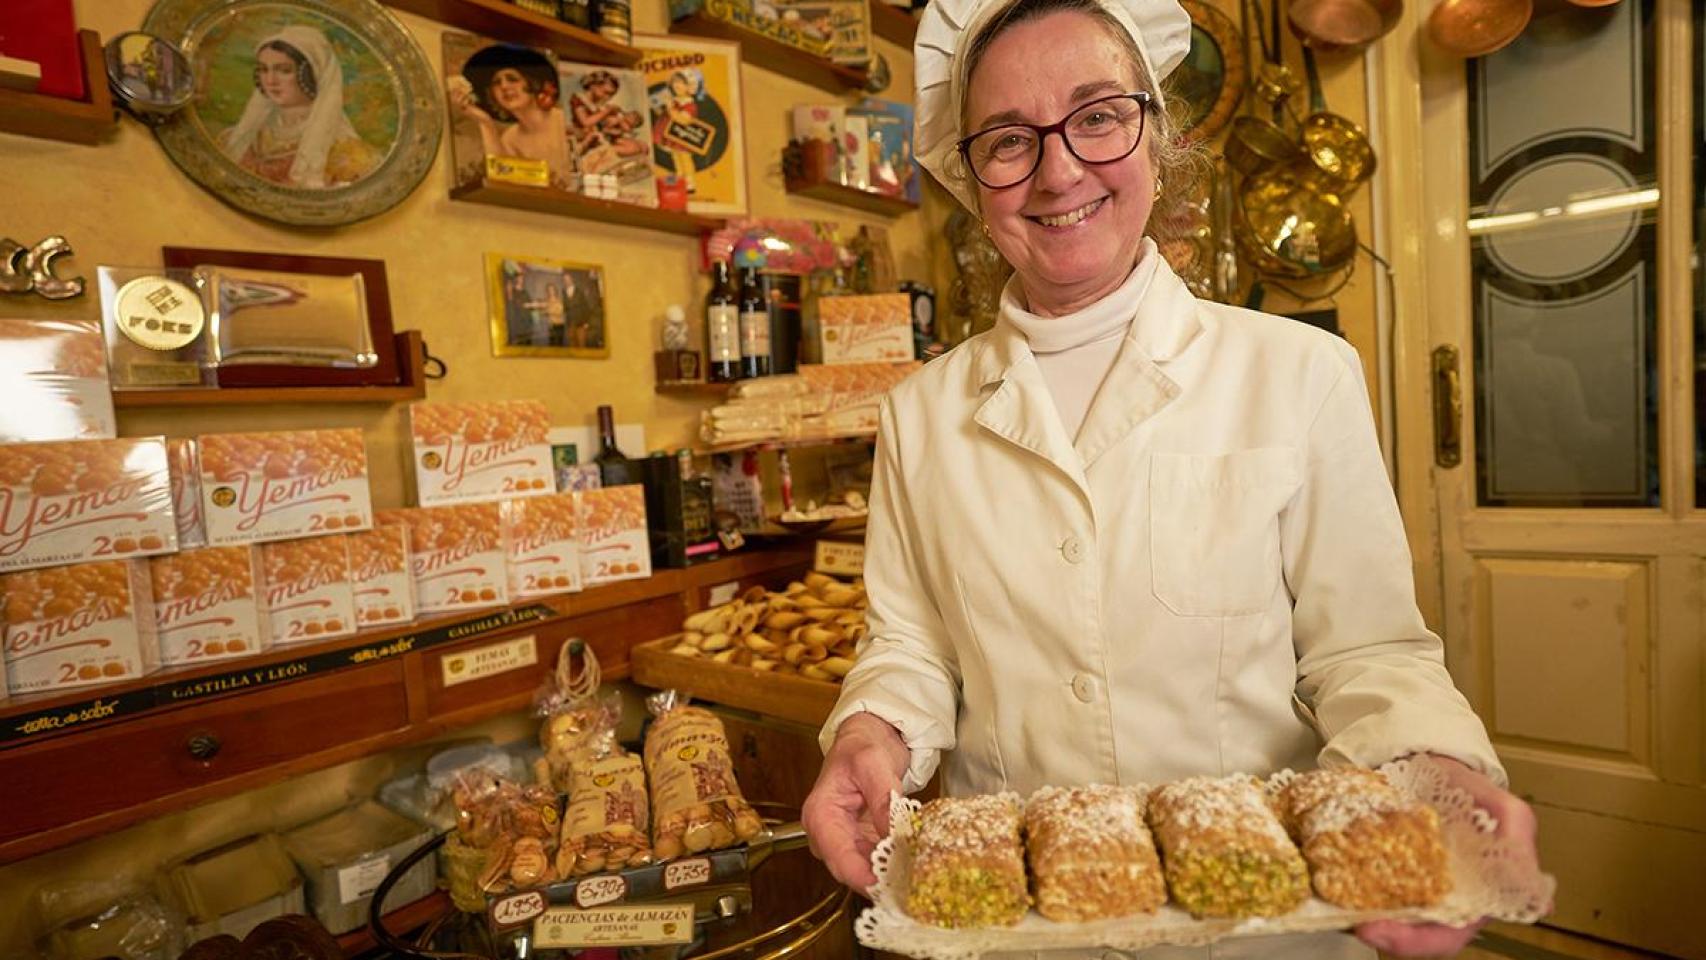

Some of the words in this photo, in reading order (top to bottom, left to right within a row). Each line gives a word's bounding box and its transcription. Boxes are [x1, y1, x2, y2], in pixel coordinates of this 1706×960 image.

[0, 464, 147, 556] Yema
[228, 453, 351, 531] Yemas
[413, 532, 489, 576] emas
[8, 598, 113, 653] emas
[172, 676, 251, 699] CASTILLA
[254, 671, 265, 683] Y
[268, 662, 309, 679] LEÓN
[542, 911, 615, 924] PACIENCIAS
[617, 911, 631, 922] de
[633, 906, 688, 921] ALMAZÁN
